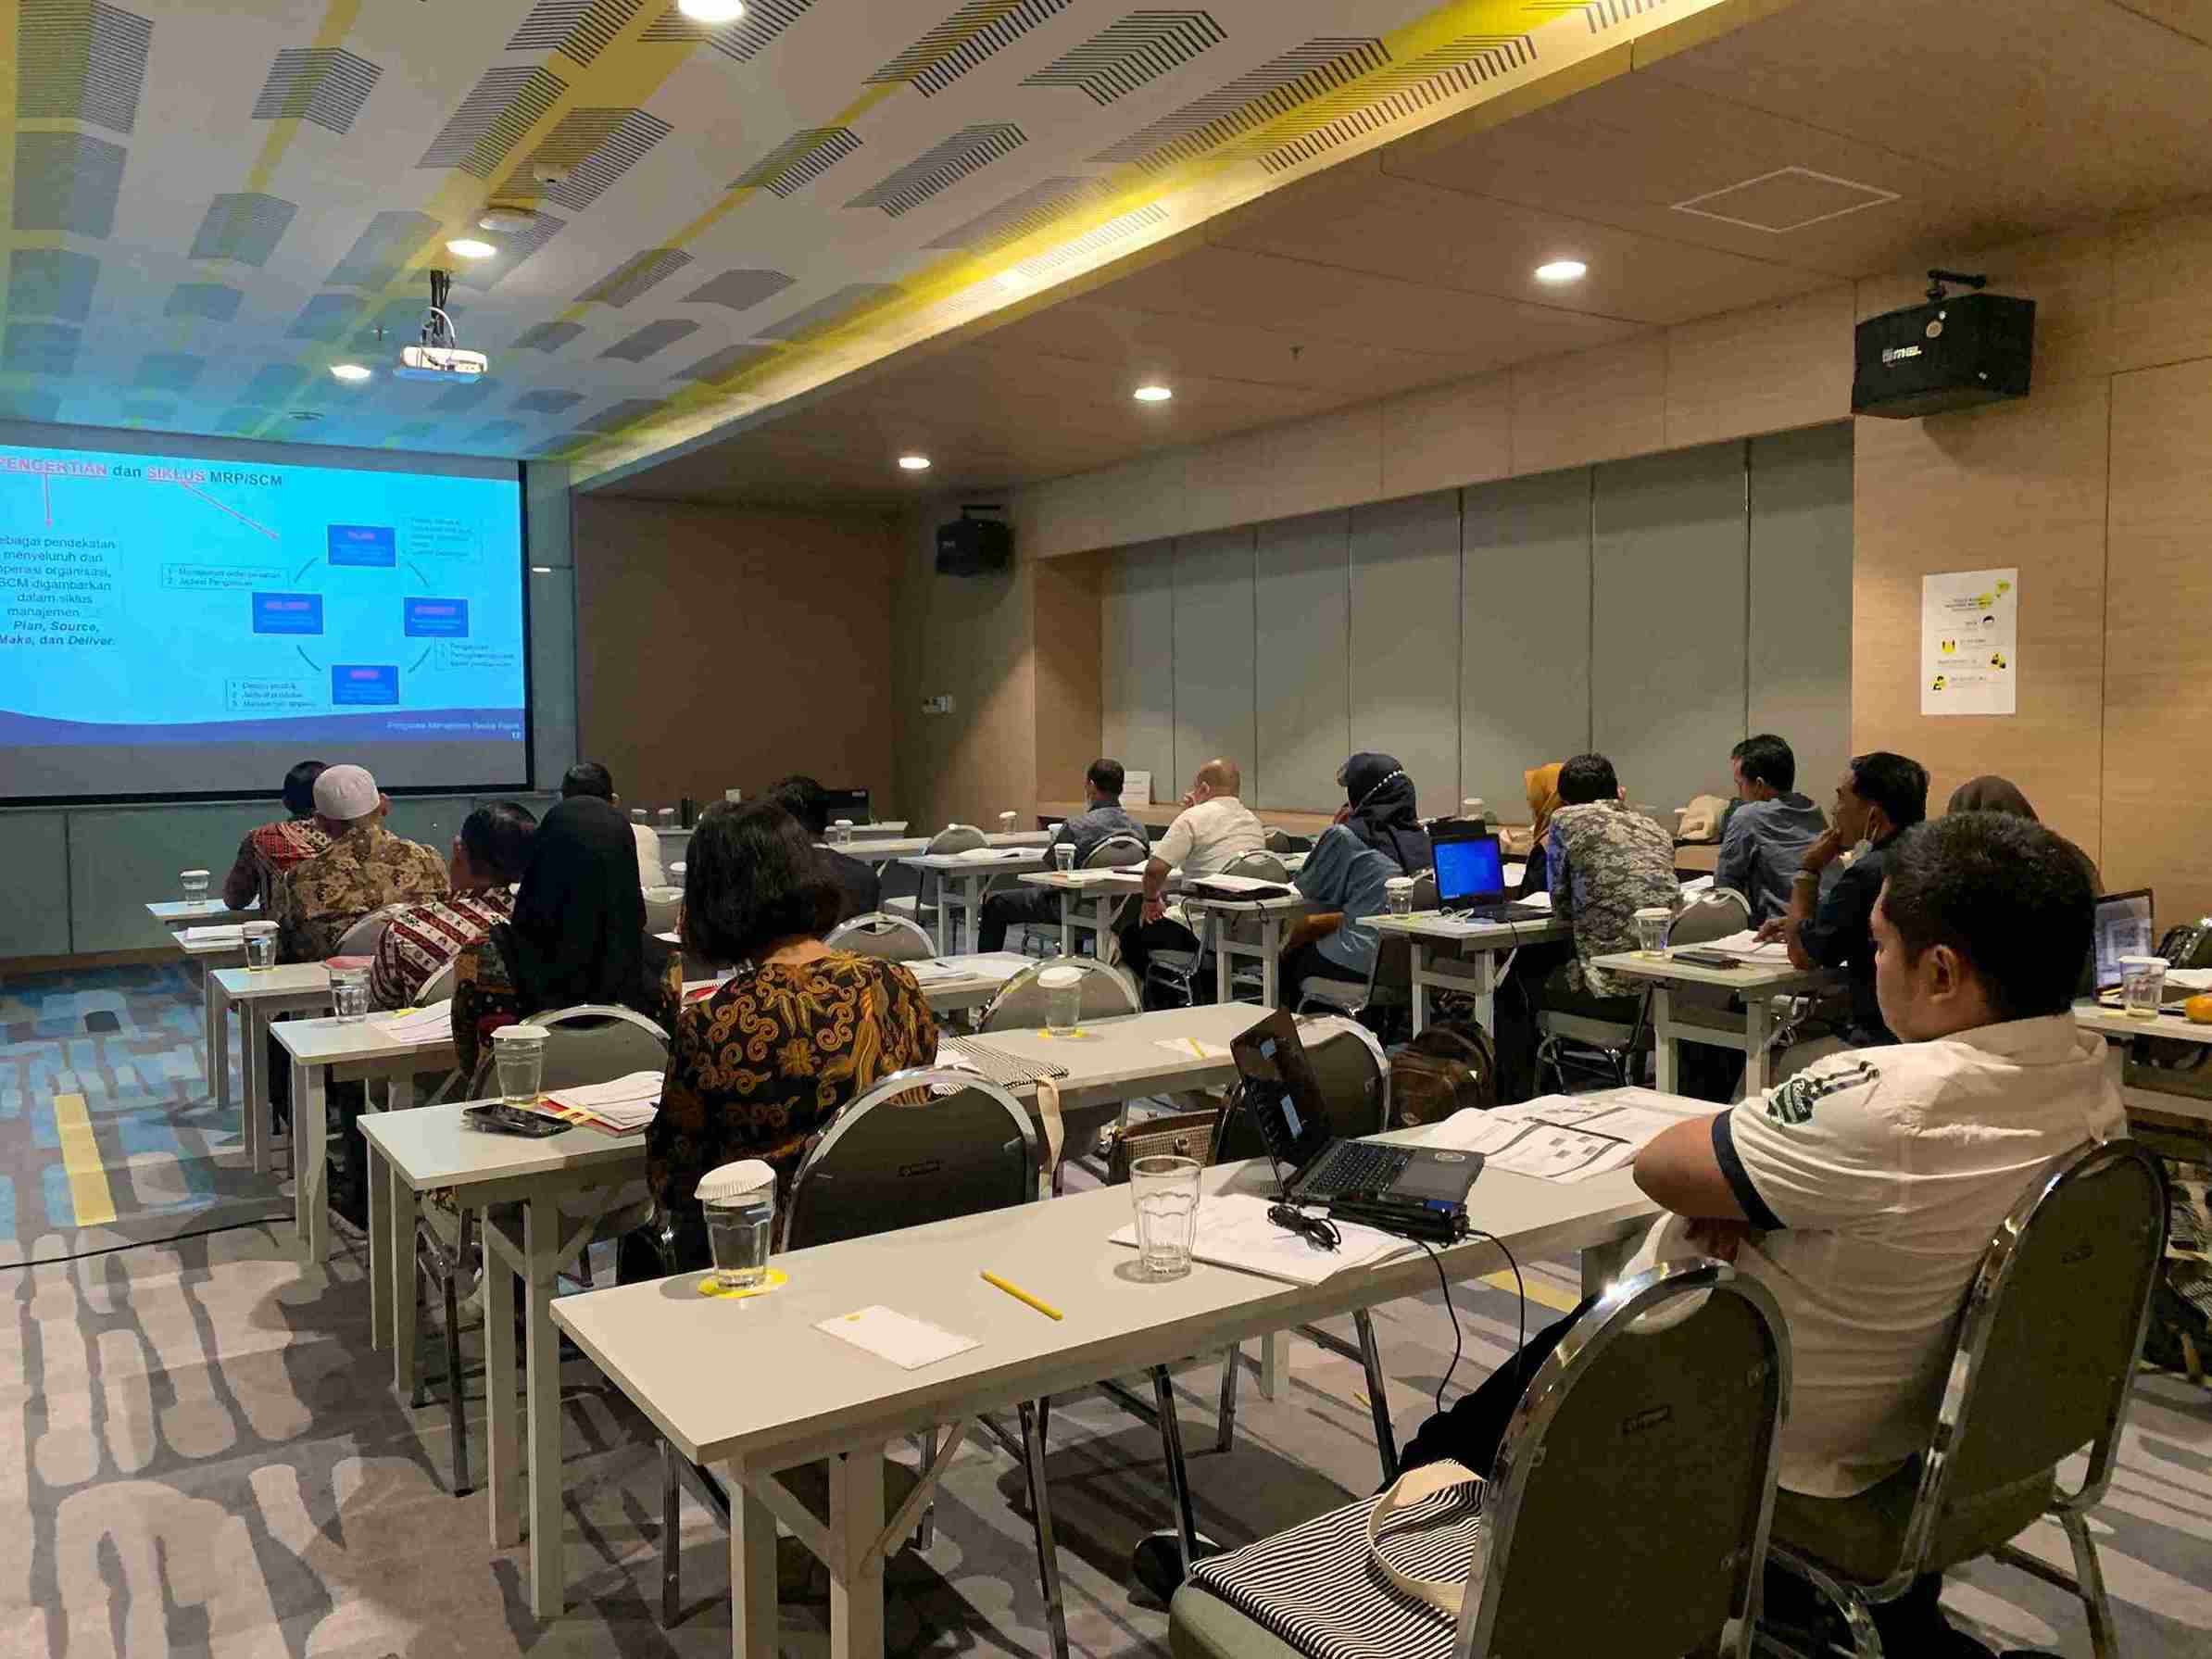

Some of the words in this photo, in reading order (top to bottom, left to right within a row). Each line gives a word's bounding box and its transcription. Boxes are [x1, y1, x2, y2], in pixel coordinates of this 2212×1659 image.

[112, 464, 142, 477] dan
[148, 467, 207, 481] SIKLUS
[210, 471, 283, 486] MRP/SCM
[44, 537, 116, 548] pendekatan
[81, 553, 103, 562] dan
[0, 577, 29, 587] SCM
[14, 621, 46, 633] Plan,
[40, 635, 65, 645] dan
